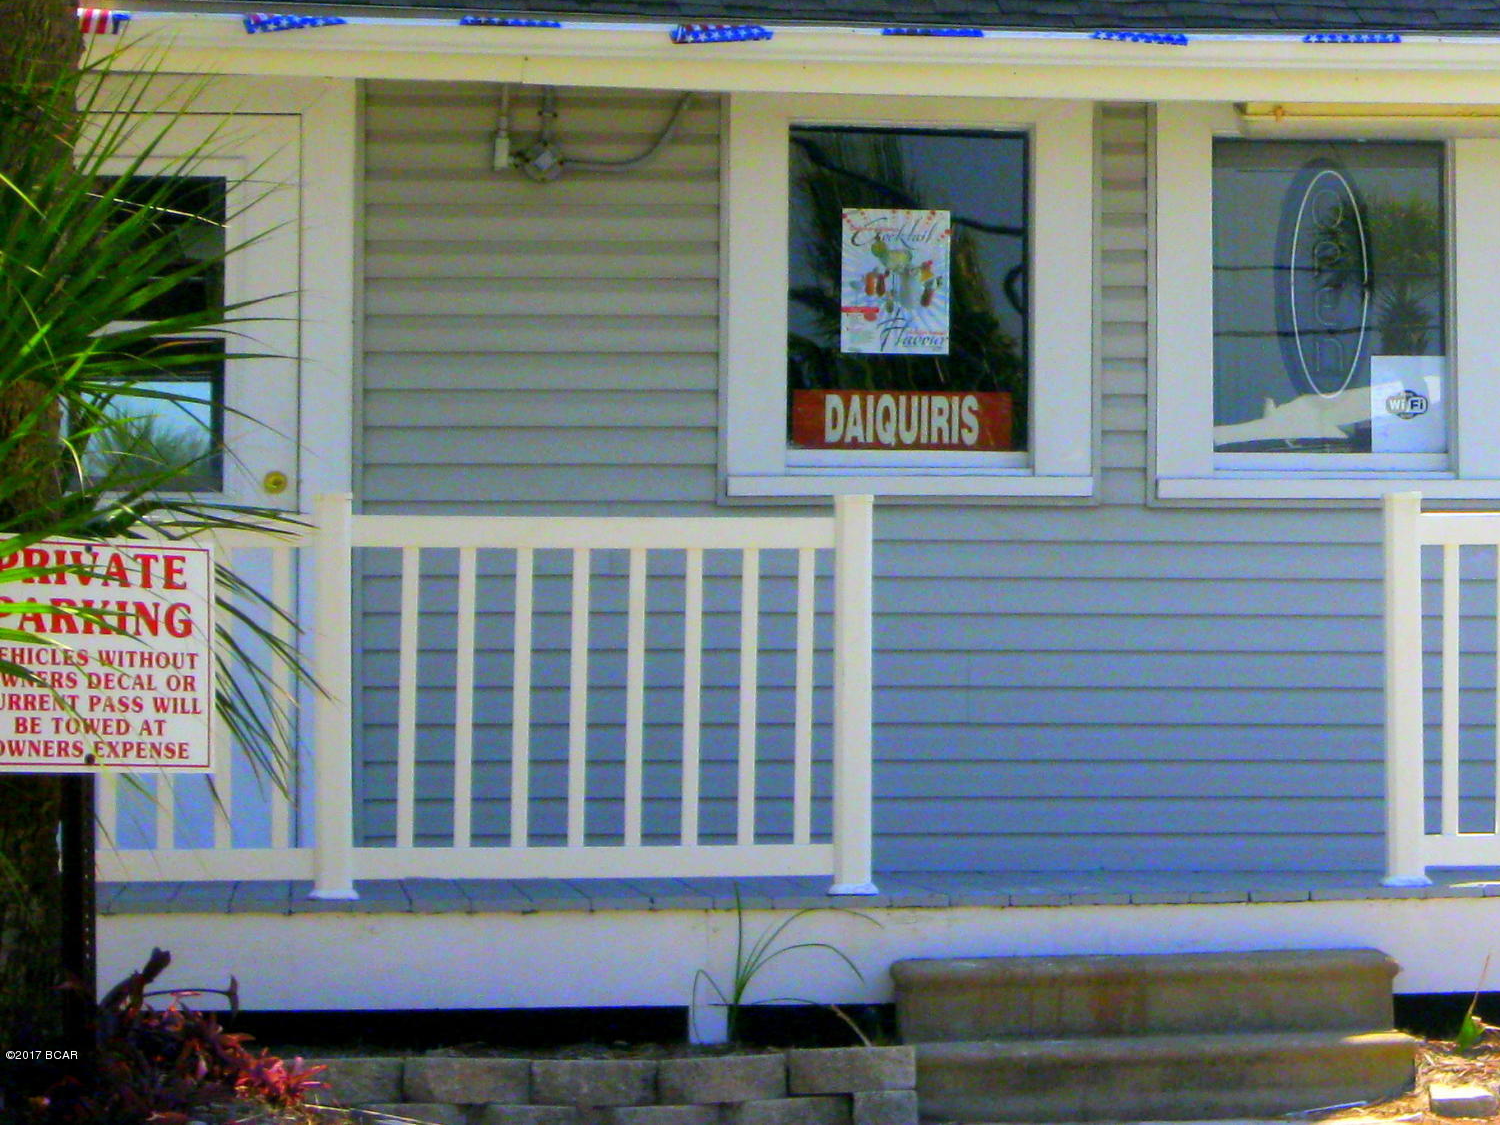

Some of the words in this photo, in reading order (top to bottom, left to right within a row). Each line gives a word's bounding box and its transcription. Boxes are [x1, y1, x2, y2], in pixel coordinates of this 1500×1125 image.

[823, 393, 981, 446] DAIQUIRIS
[0, 647, 90, 667] EHICLES
[98, 650, 199, 670] WITHOUT
[0, 670, 78, 690] WERS
[87, 672, 157, 692] DECAL
[166, 674, 196, 692] OR
[0, 693, 80, 713] RRENT
[88, 695, 144, 714] PASS
[152, 697, 202, 715] WILL
[15, 716, 42, 735] BE
[51, 717, 131, 737] TOWED
[139, 719, 167, 737] AT
[94, 741, 190, 760] EXPENSE
